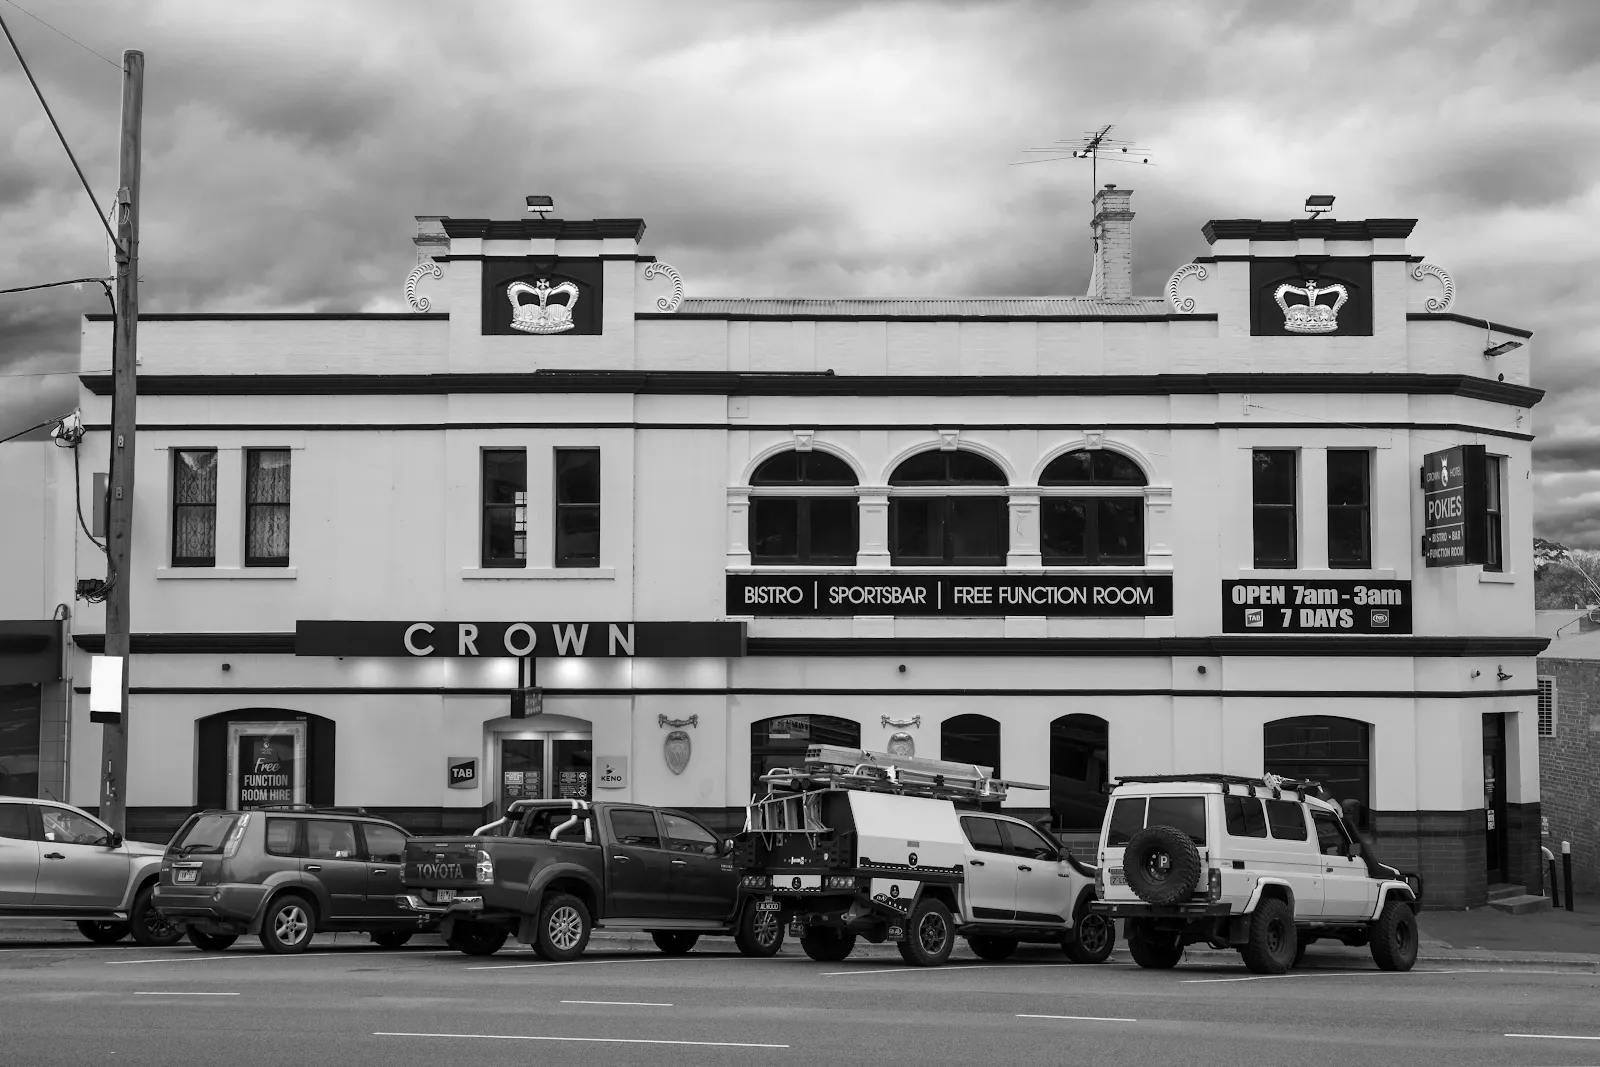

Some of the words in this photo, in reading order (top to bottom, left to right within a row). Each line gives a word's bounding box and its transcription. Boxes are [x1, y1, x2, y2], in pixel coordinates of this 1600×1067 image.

[1428, 495, 1462, 521] POKIES
[1431, 531, 1448, 543] BISTRO
[1451, 530, 1461, 541] BAR
[1429, 547, 1450, 559] FUNCTION
[1450, 545, 1464, 558] ROOM
[744, 586, 803, 604] BISTRO
[829, 586, 927, 604] SPORTSBAR
[954, 586, 993, 604] FREE
[999, 586, 1087, 604] FUNCTION
[1093, 586, 1154, 604] ROOM
[1231, 585, 1286, 605] OPEN
[1292, 585, 1339, 605] 7am
[1353, 585, 1402, 605] 3am
[1280, 608, 1293, 628] 7
[1300, 608, 1354, 628] DAYS
[403, 622, 635, 656] CROWN
[254, 757, 280, 773] Free
[452, 768, 473, 778] TAB
[244, 774, 289, 786] FUNCTION
[241, 789, 268, 801] ROOM
[269, 789, 291, 801] HIRE
[1160, 855, 1168, 867] P
[416, 863, 464, 879] TOYOTA
